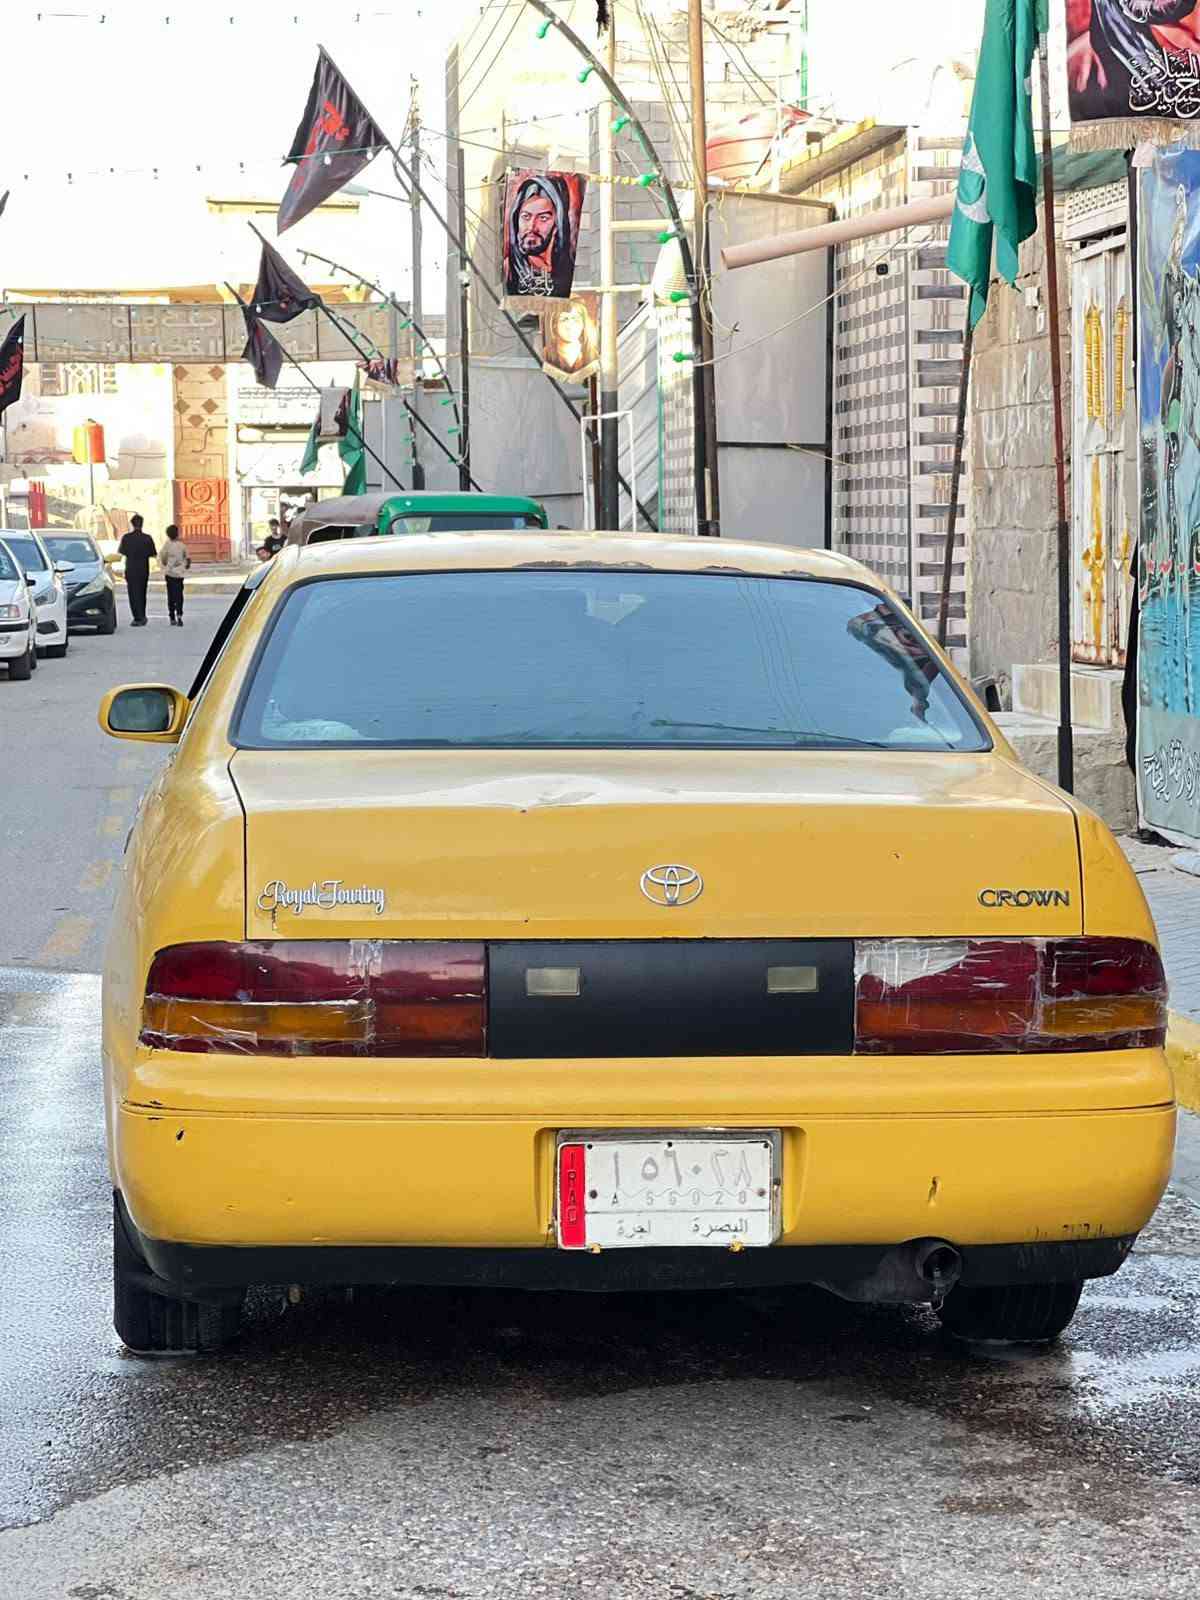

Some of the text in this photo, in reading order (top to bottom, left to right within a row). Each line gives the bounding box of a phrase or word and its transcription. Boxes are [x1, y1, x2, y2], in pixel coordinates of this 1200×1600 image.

[257, 880, 318, 915] Royal
[978, 888, 1070, 908] CROWN
[691, 1216, 749, 1239] البصرة
